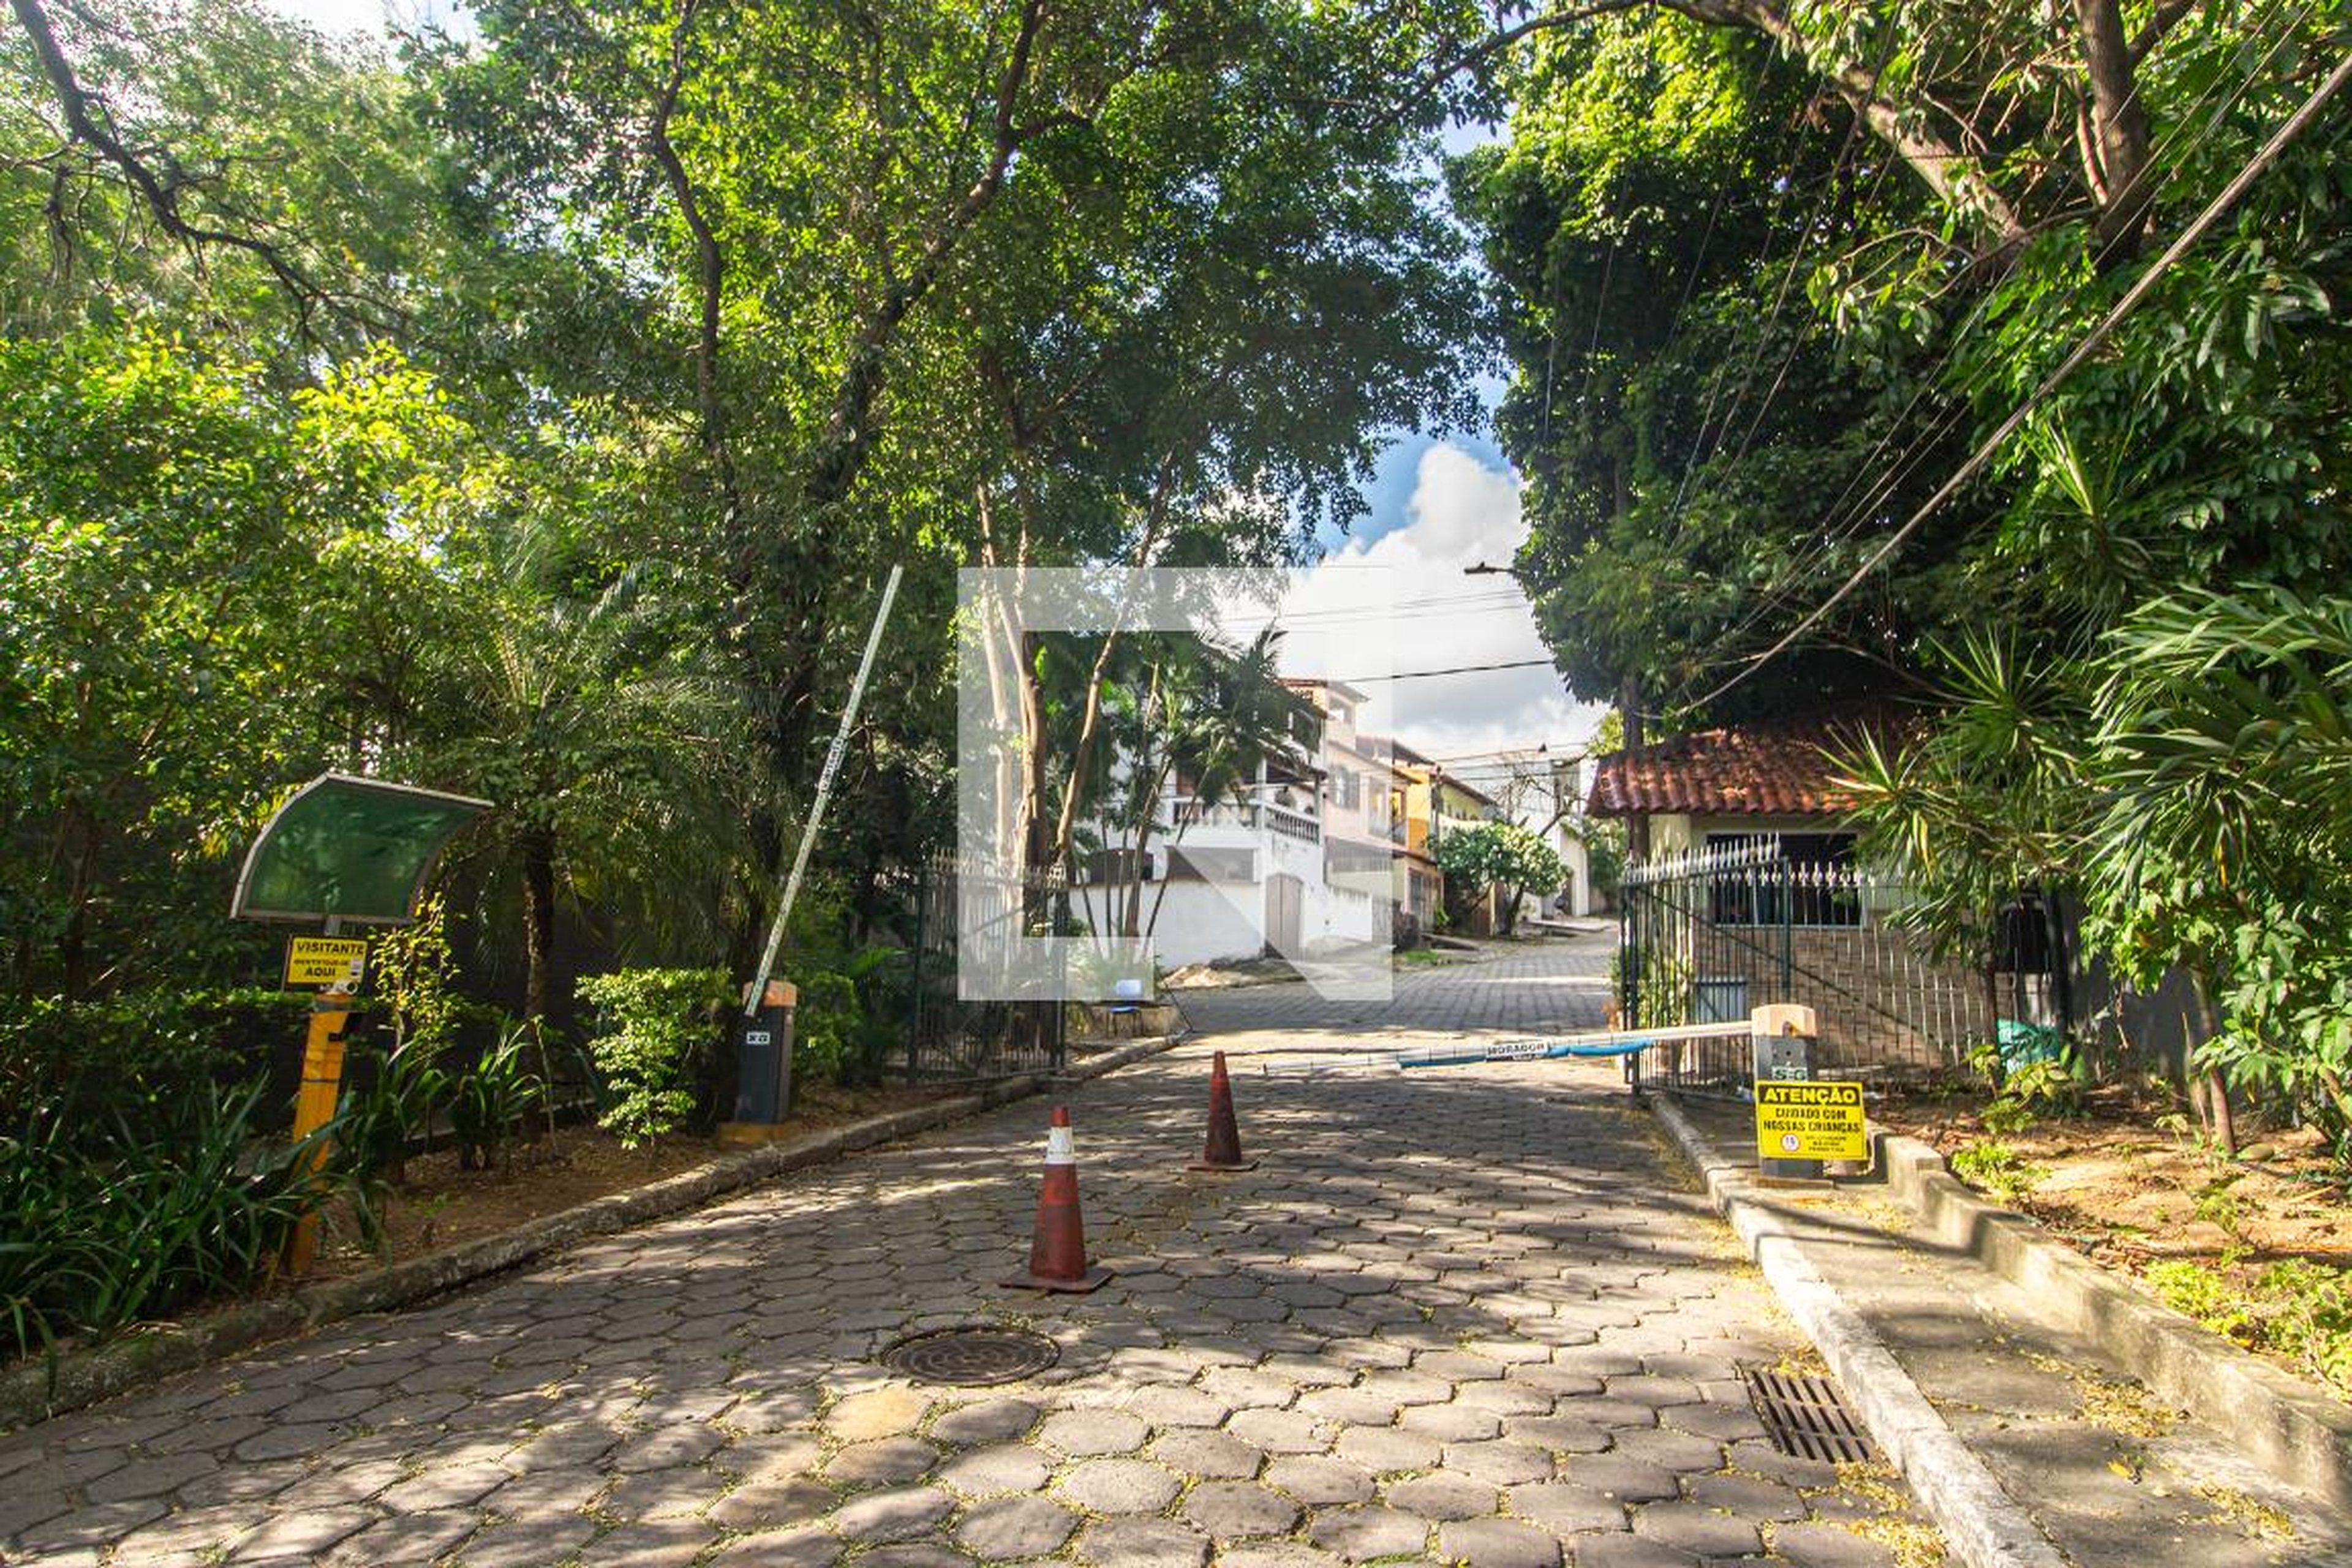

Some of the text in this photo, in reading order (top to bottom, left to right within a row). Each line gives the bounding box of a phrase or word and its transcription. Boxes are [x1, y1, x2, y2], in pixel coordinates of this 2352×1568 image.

[298, 941, 363, 954] VISITANTE
[304, 967, 336, 976] AQUI
[1765, 1087, 1856, 1105] ATENÇÃO
[1776, 1108, 1846, 1120] CUIDADO COM
[1764, 1120, 1806, 1131] NOSSAS
